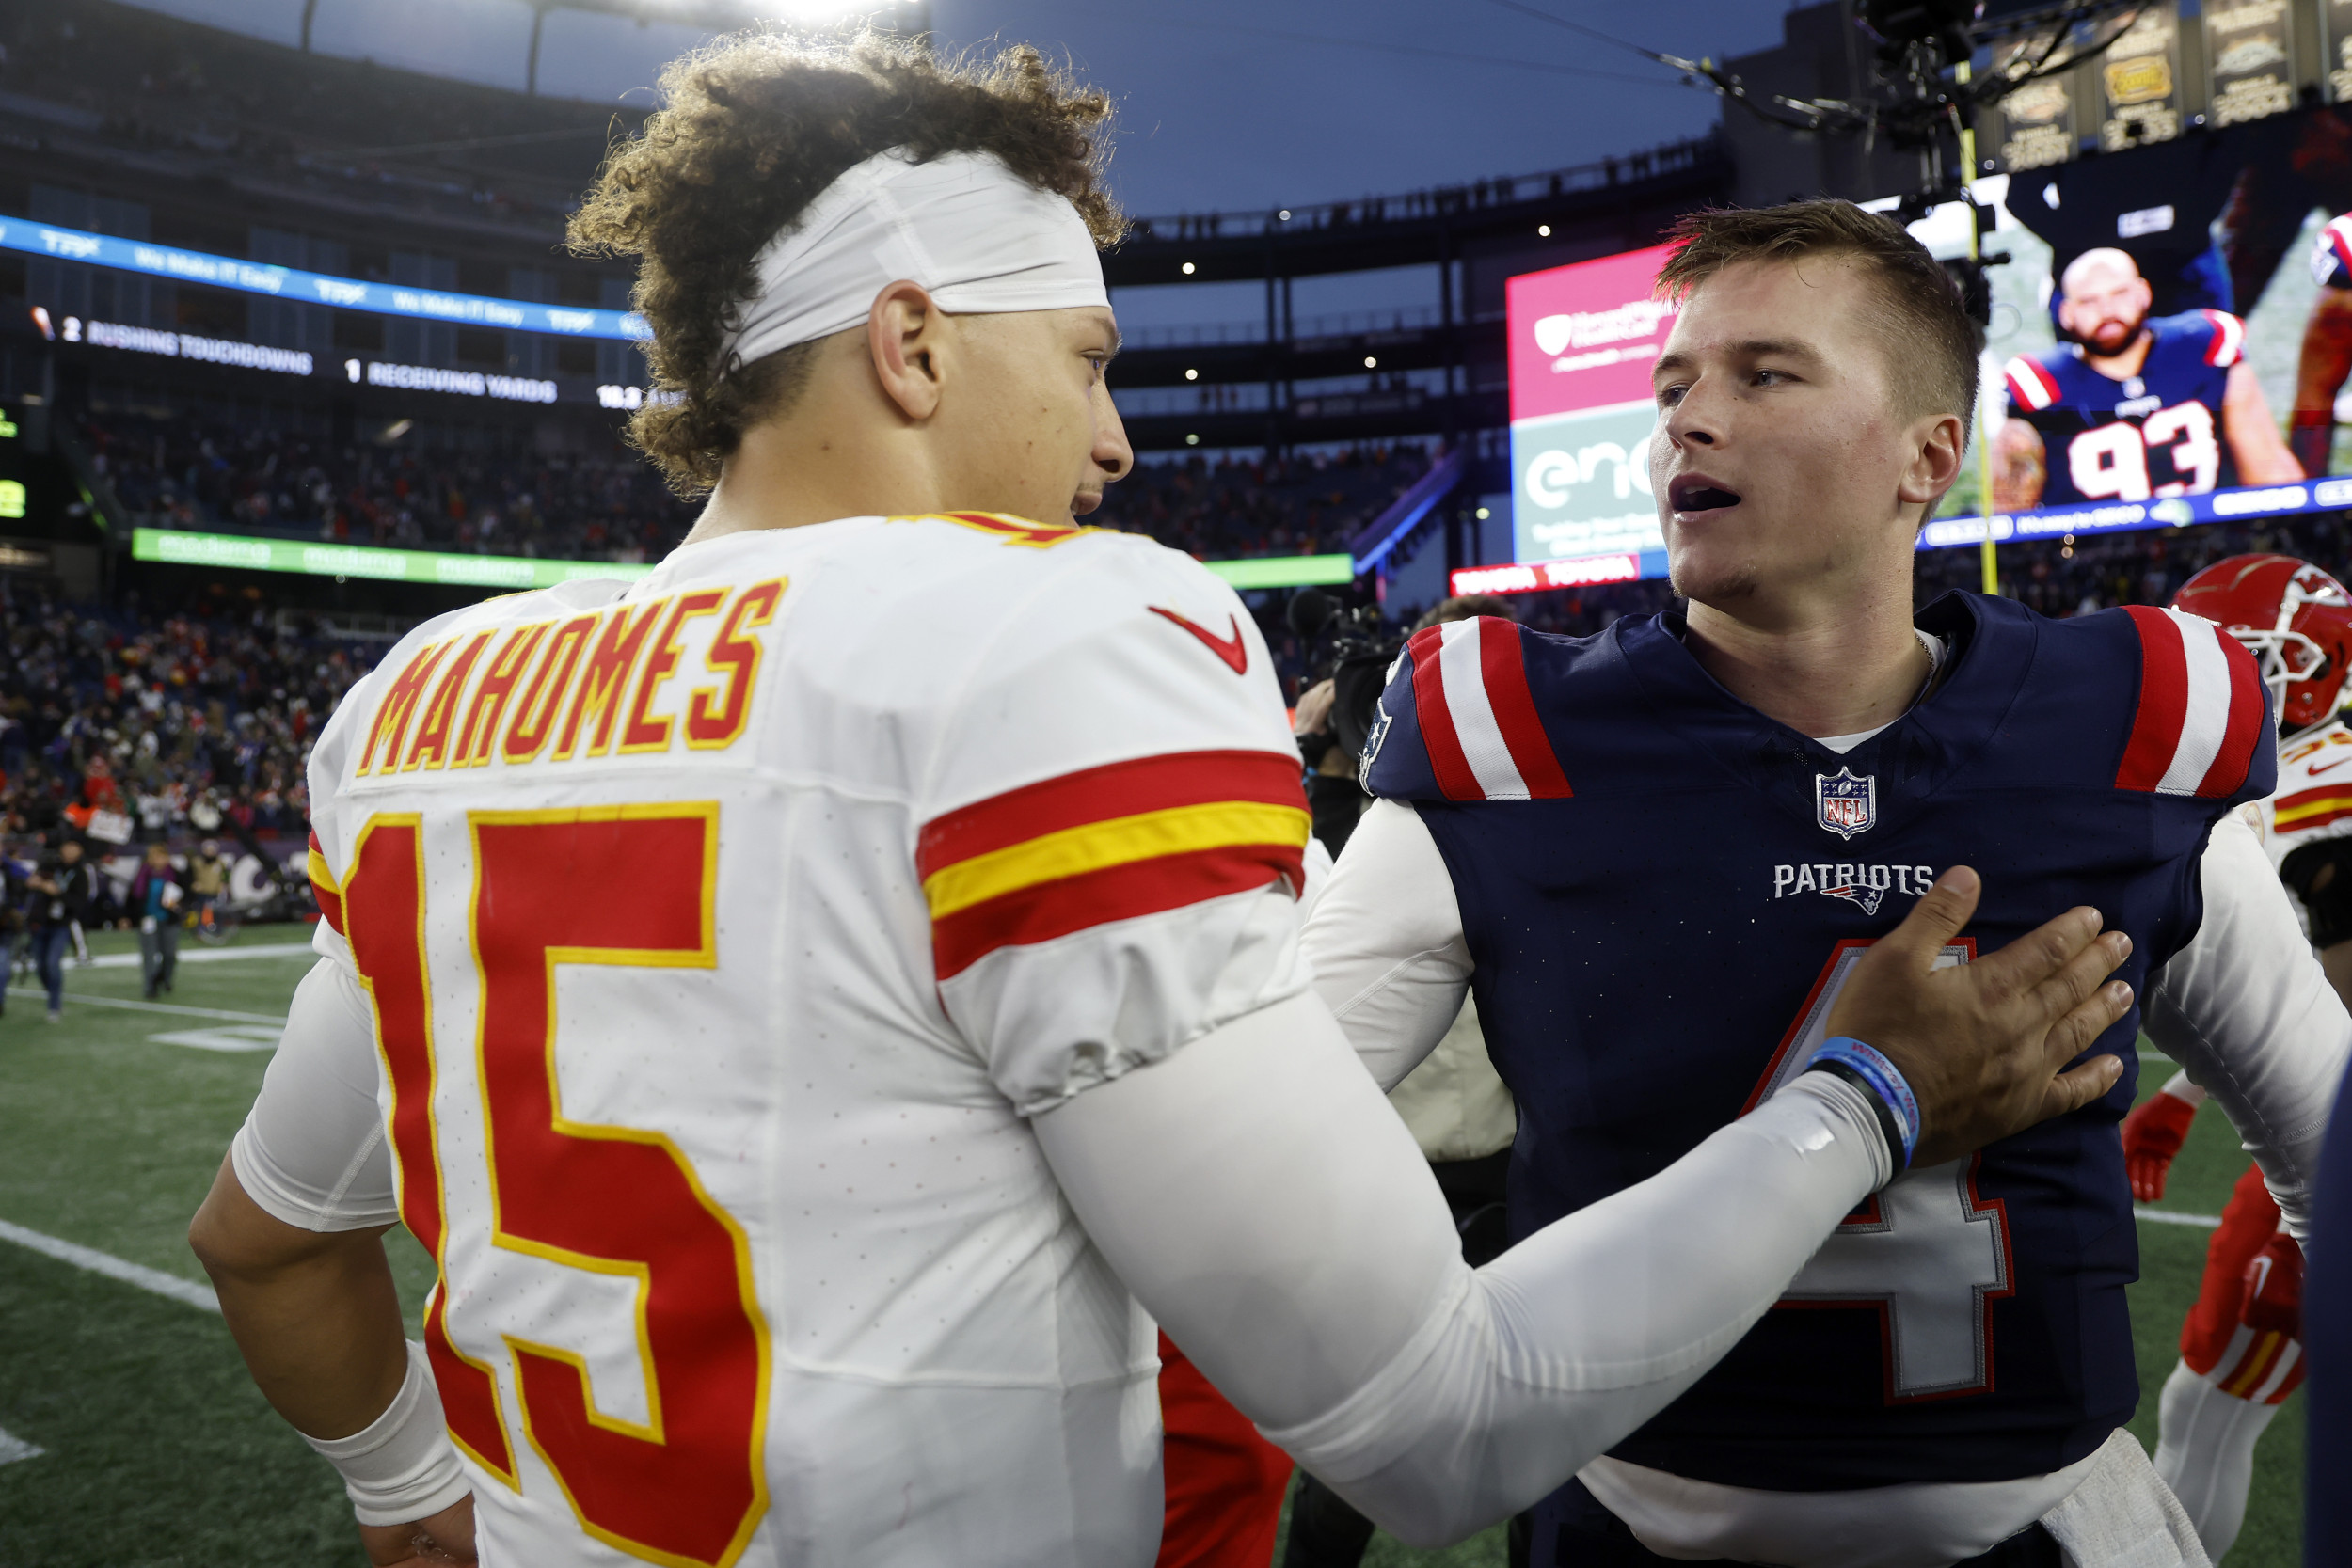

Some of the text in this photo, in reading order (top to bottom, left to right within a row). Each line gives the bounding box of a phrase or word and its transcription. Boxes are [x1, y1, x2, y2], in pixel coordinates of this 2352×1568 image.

[135, 246, 166, 271] We
[167, 252, 218, 281] Make
[239, 265, 283, 294] Easy
[392, 291, 422, 312] We
[423, 294, 465, 318] Make
[484, 302, 524, 328] Easy
[63, 316, 82, 341] 2
[87, 320, 179, 356] RUSHING
[179, 334, 313, 376] TOUCHDOWNS
[344, 358, 361, 383] 1
[367, 361, 486, 396] RECEIVING
[485, 374, 558, 404] YARDS
[2068, 399, 2220, 502] 93
[1452, 556, 1635, 595] TOYOTA TOYOTA
[357, 575, 788, 778] MAHOMES
[1825, 799, 1867, 826] NFL
[1773, 863, 1934, 898] PATRIOTS
[341, 800, 772, 1568] 15
